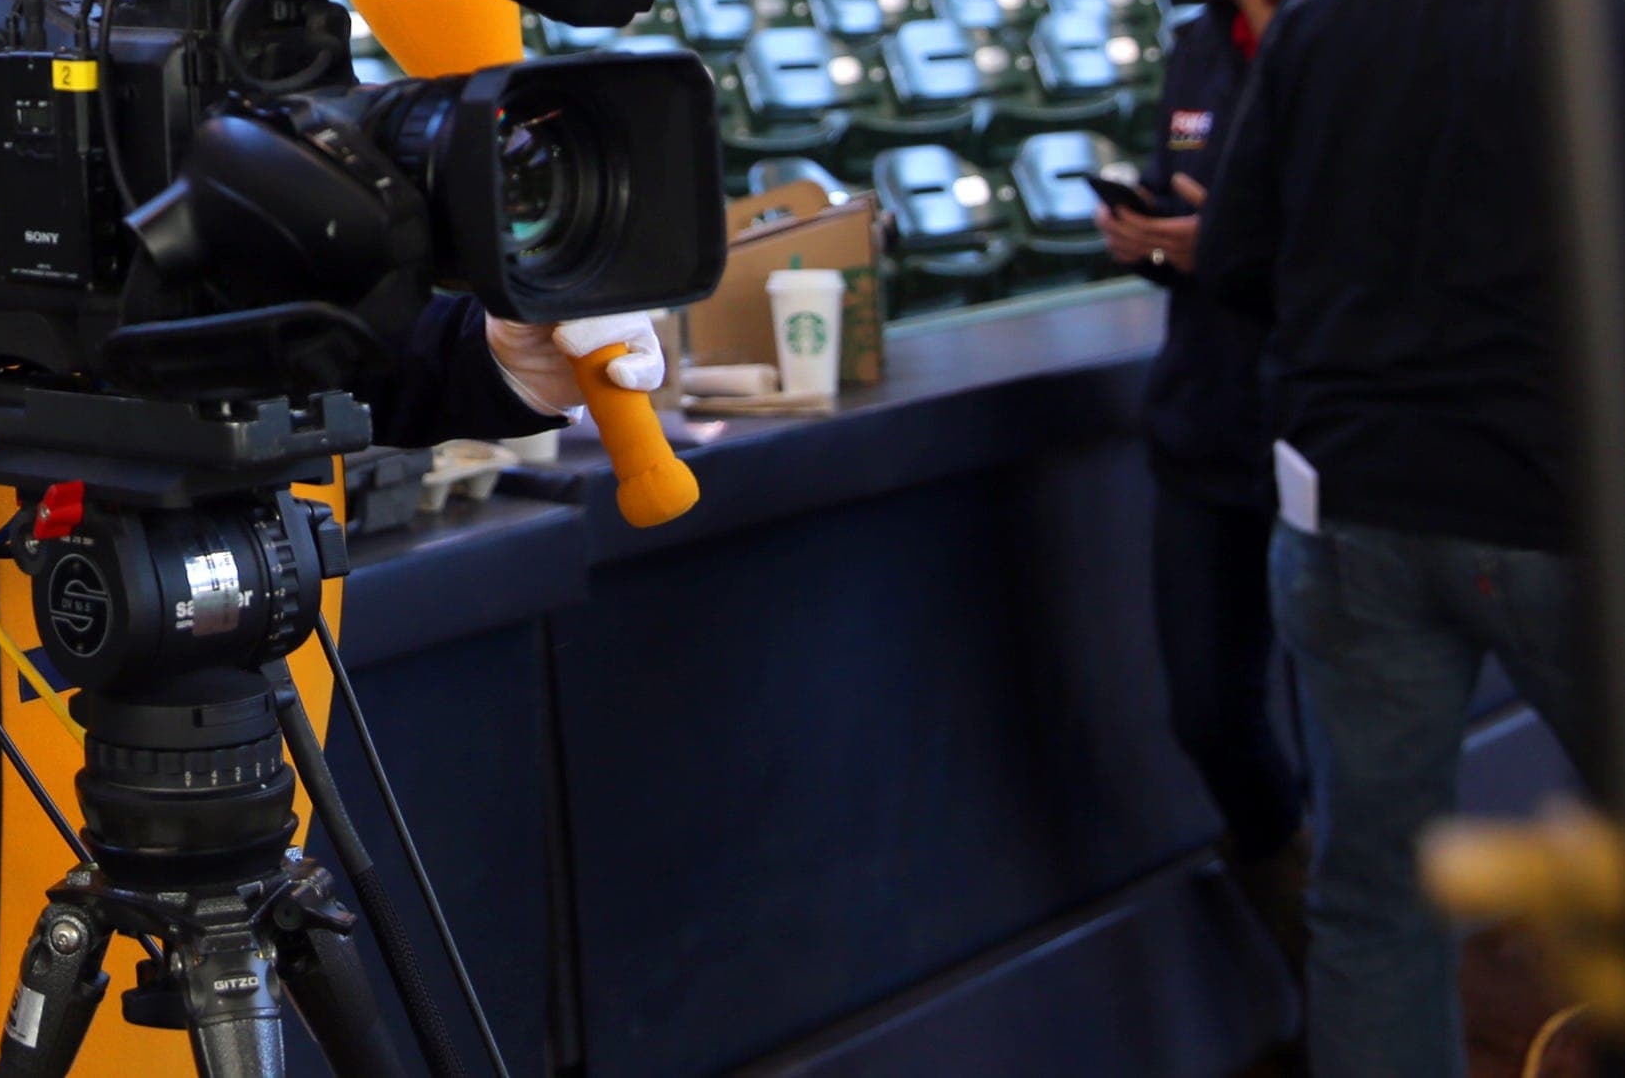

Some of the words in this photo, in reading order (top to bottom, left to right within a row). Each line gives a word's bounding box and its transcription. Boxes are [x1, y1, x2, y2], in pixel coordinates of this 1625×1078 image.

[62, 65, 72, 85] 2
[24, 229, 60, 245] SONY
[214, 976, 259, 991] GITZO
